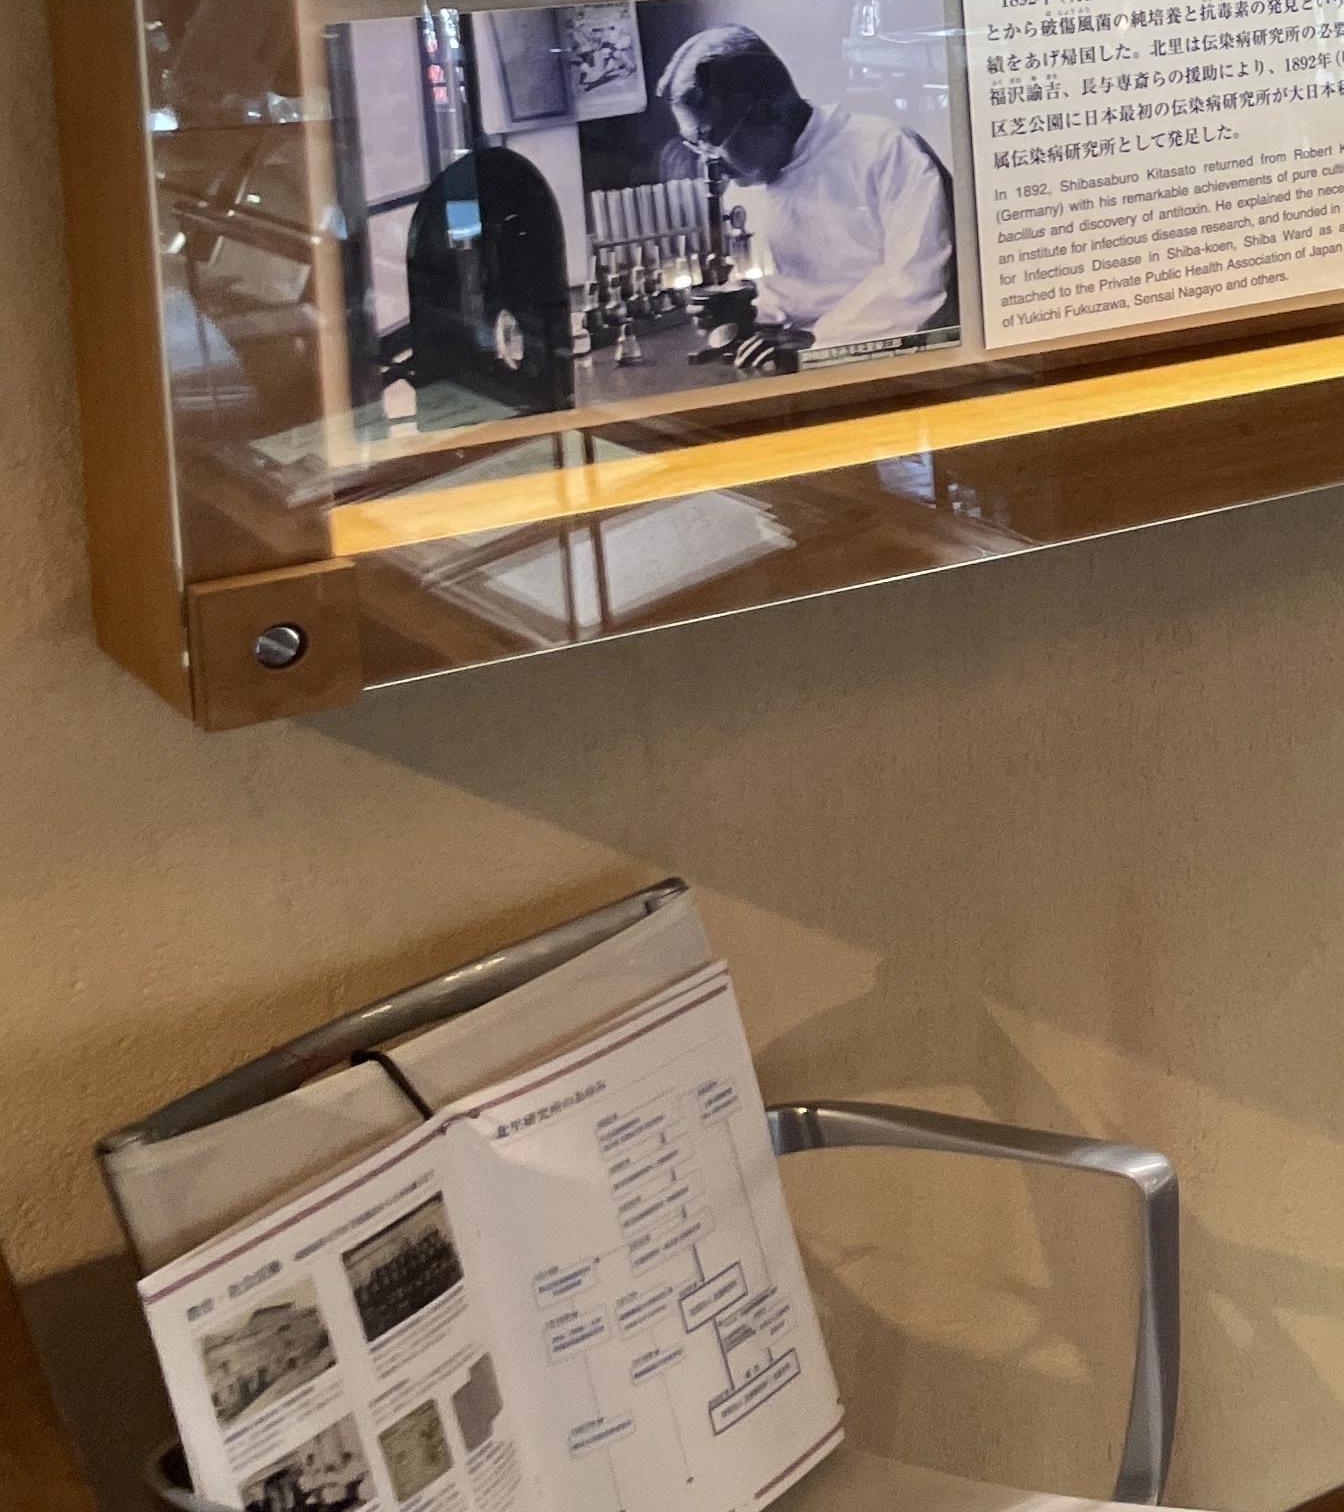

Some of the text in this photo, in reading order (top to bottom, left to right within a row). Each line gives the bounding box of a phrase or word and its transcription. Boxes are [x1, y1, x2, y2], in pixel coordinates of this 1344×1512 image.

[994, 189, 1007, 201] In
[1016, 183, 1051, 197] 1892,
[1059, 173, 1138, 192] Shibasaburo
[1146, 164, 1196, 180] Kitasato
[1203, 155, 1253, 172] returned
[1260, 153, 1286, 164] from
[1293, 145, 1332, 160] Robert
[996, 202, 1063, 224] (Germany)
[1068, 198, 1094, 211] with
[1098, 195, 1117, 207] his
[1122, 185, 1188, 203] remarkable
[1193, 174, 1272, 194] achievements
[1276, 169, 1287, 182] of
[1291, 168, 1317, 183] pure
[997, 227, 1045, 243] bacillus
[1050, 221, 1074, 235] and
[1079, 214, 1137, 231] discovery
[1141, 209, 1153, 222] of
[1215, 199, 1232, 211] He
[1236, 190, 1290, 208] explained
[1295, 187, 1313, 199] the
[1001, 314, 1014, 327] of
[1016, 307, 1060, 325] Yukichi
[1133, 288, 1174, 305] Sensai
[1178, 283, 1222, 298] Nagayo
[1225, 276, 1247, 290] and
